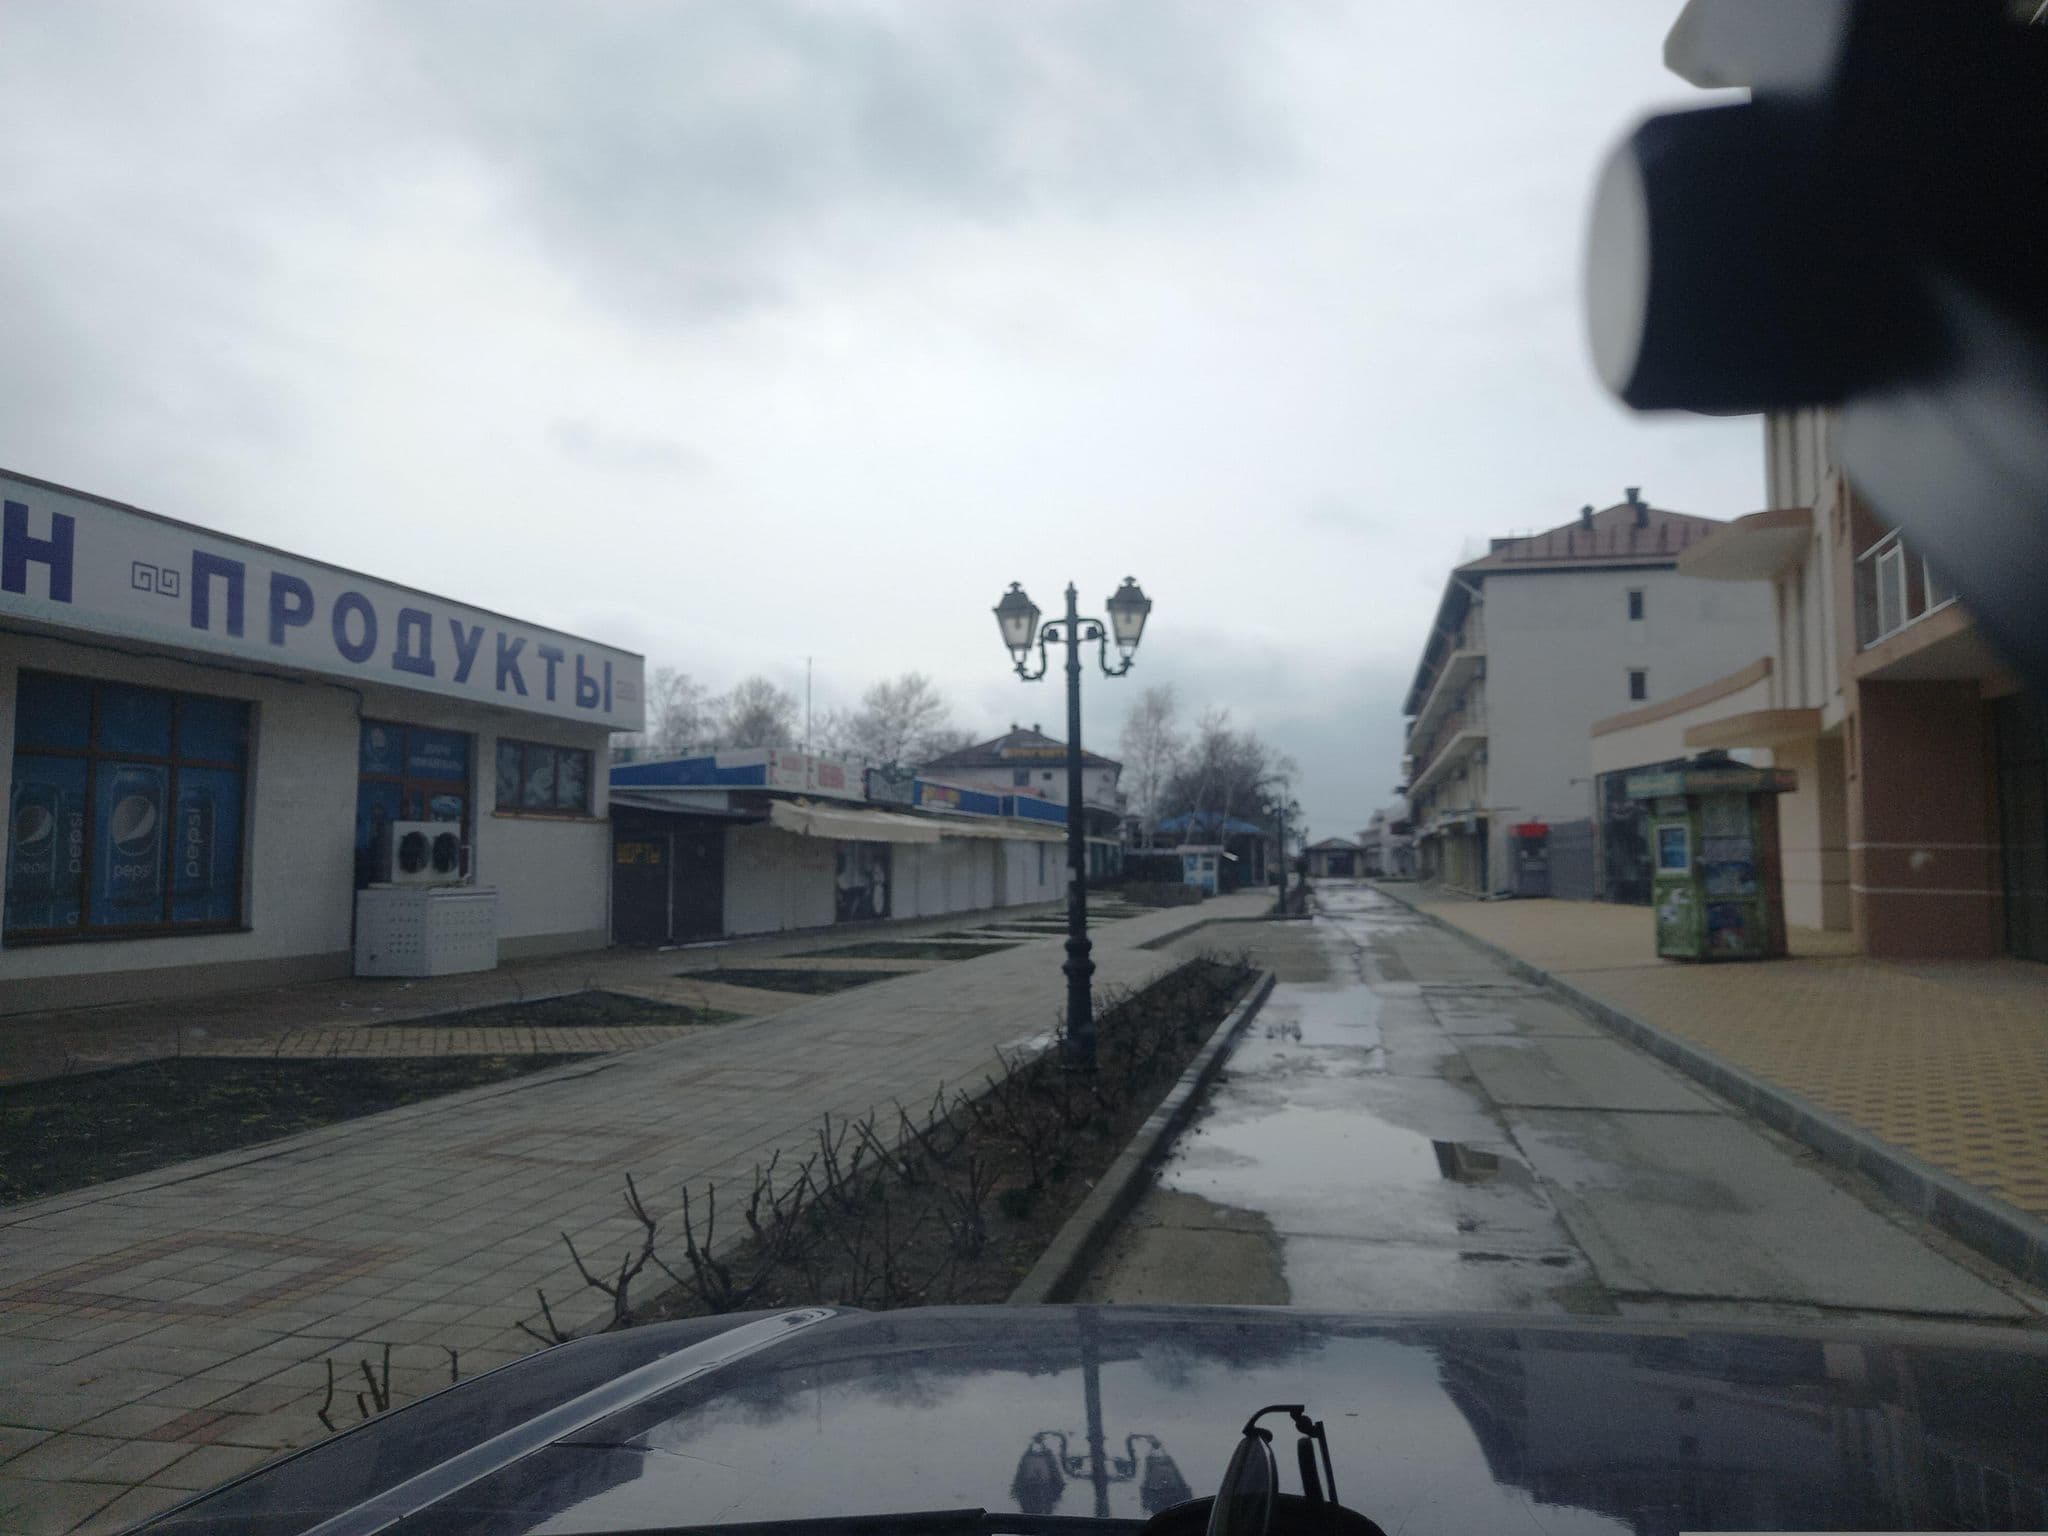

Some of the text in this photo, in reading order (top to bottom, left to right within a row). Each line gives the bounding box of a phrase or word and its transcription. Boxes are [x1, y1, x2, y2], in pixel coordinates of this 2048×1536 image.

[1, 500, 613, 713] Н ПРОДУКТЫ
[185, 808, 205, 878] pepsi
